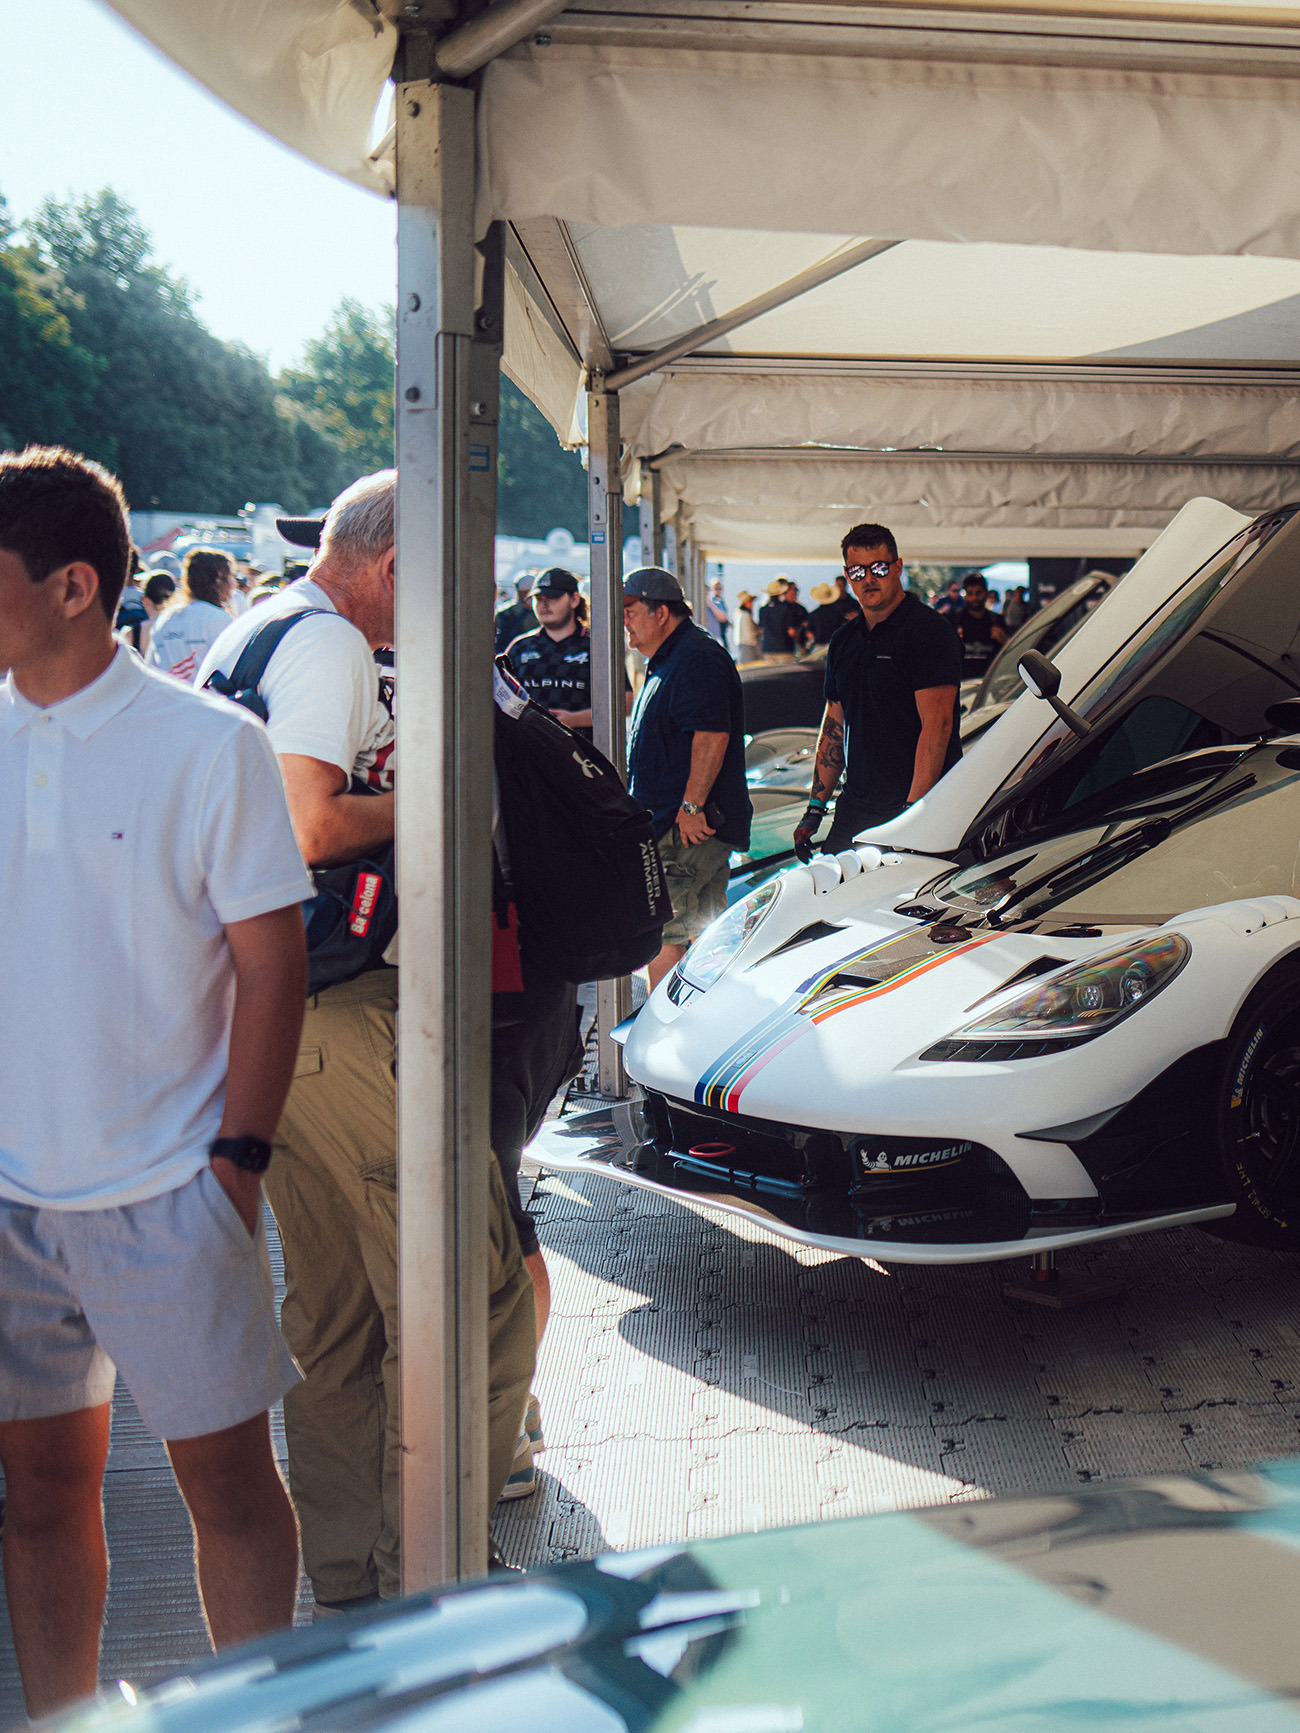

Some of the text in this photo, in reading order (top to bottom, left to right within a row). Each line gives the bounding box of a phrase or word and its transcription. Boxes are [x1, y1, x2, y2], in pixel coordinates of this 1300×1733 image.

[524, 680, 586, 690] ALPINE
[639, 843, 656, 916] ARMOUR
[648, 839, 661, 897] UNDER
[351, 876, 378, 933] Bacelona
[1237, 1028, 1263, 1085] MICHELIN
[894, 1142, 973, 1166] MICHELIN
